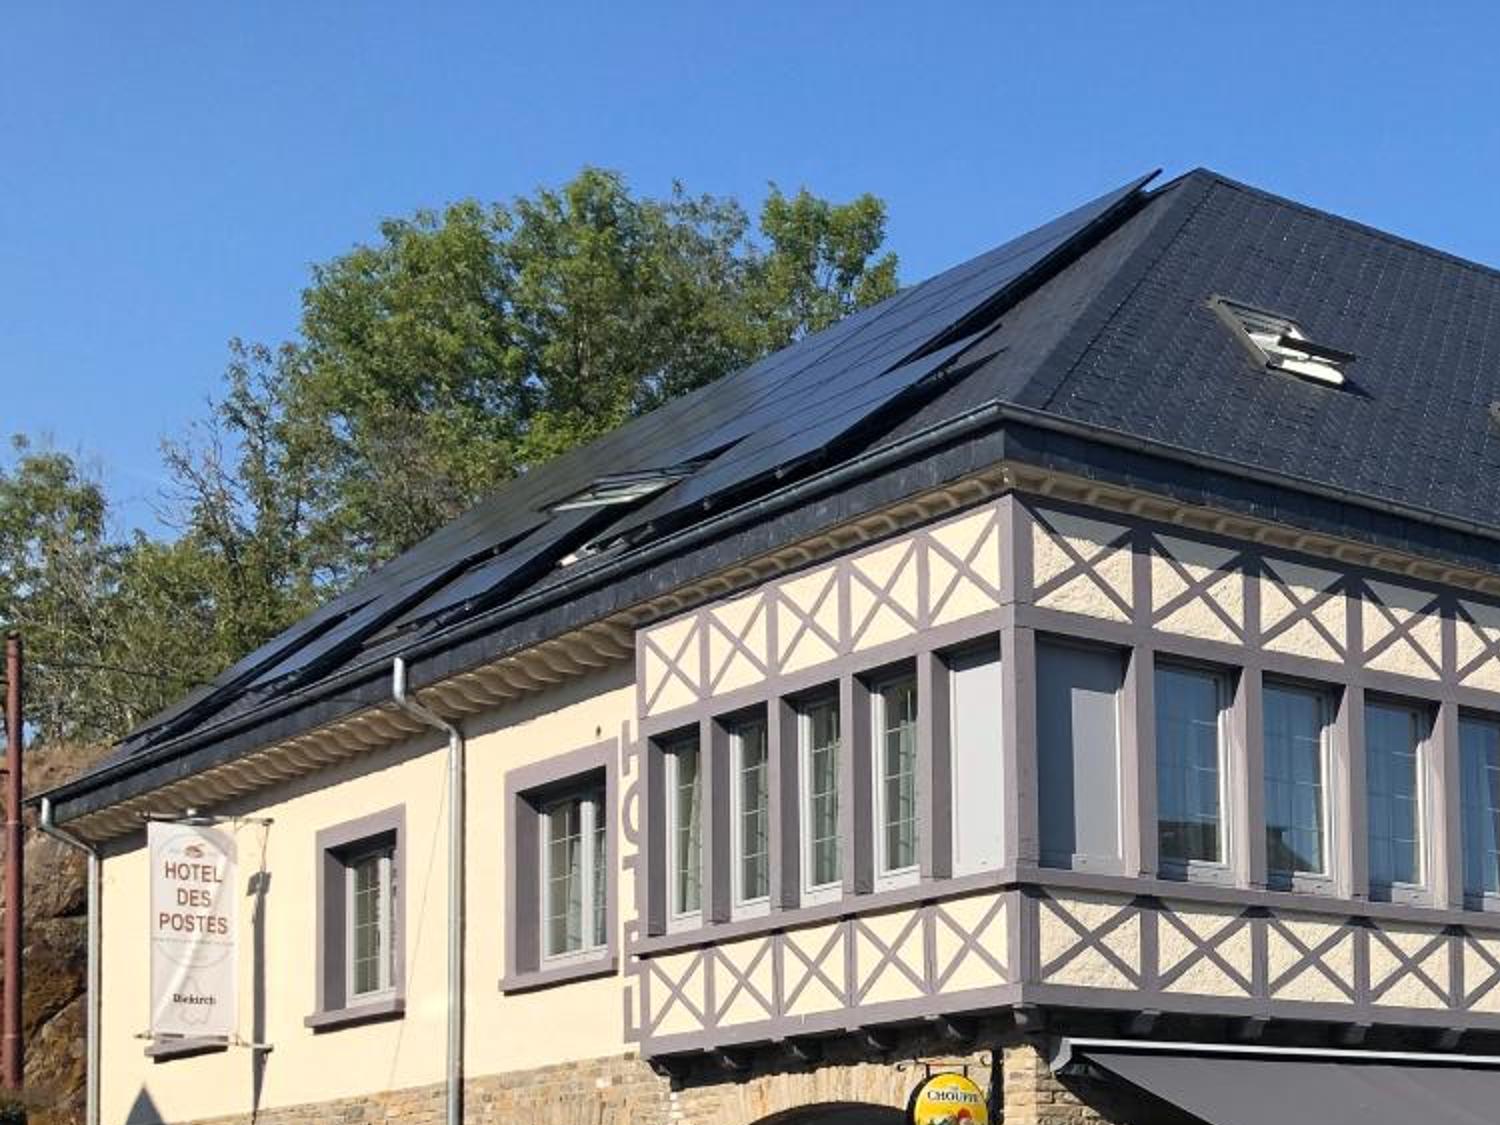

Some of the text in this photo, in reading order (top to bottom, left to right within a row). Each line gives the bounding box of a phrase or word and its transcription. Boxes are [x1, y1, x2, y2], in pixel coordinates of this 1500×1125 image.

[165, 861, 223, 884] HOTEL
[177, 888, 211, 908] DES
[159, 912, 228, 935] POSTES
[173, 993, 217, 1006] Diekirch
